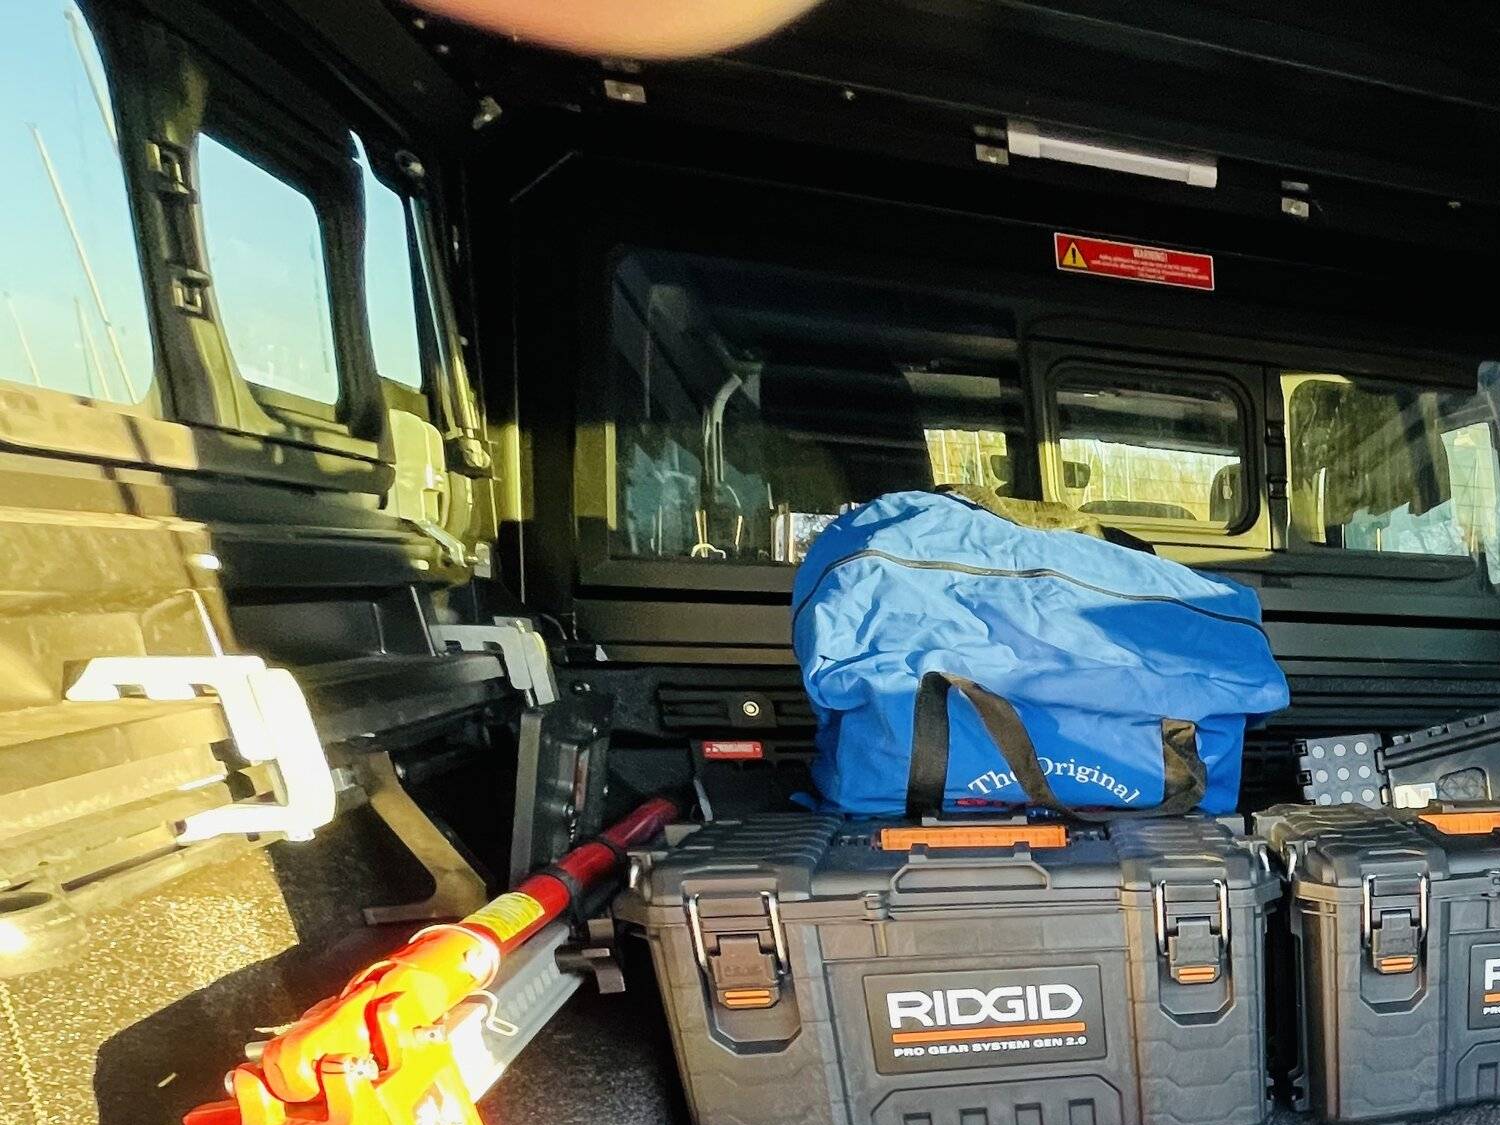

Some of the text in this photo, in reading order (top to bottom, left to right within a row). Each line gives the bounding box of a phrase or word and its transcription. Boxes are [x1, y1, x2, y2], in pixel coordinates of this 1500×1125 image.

[1037, 757, 1141, 804] Original
[886, 984, 1083, 1029] RIDGID
[893, 1035, 1088, 1058] PRO GEAR SYSTEM GEN 2.0
